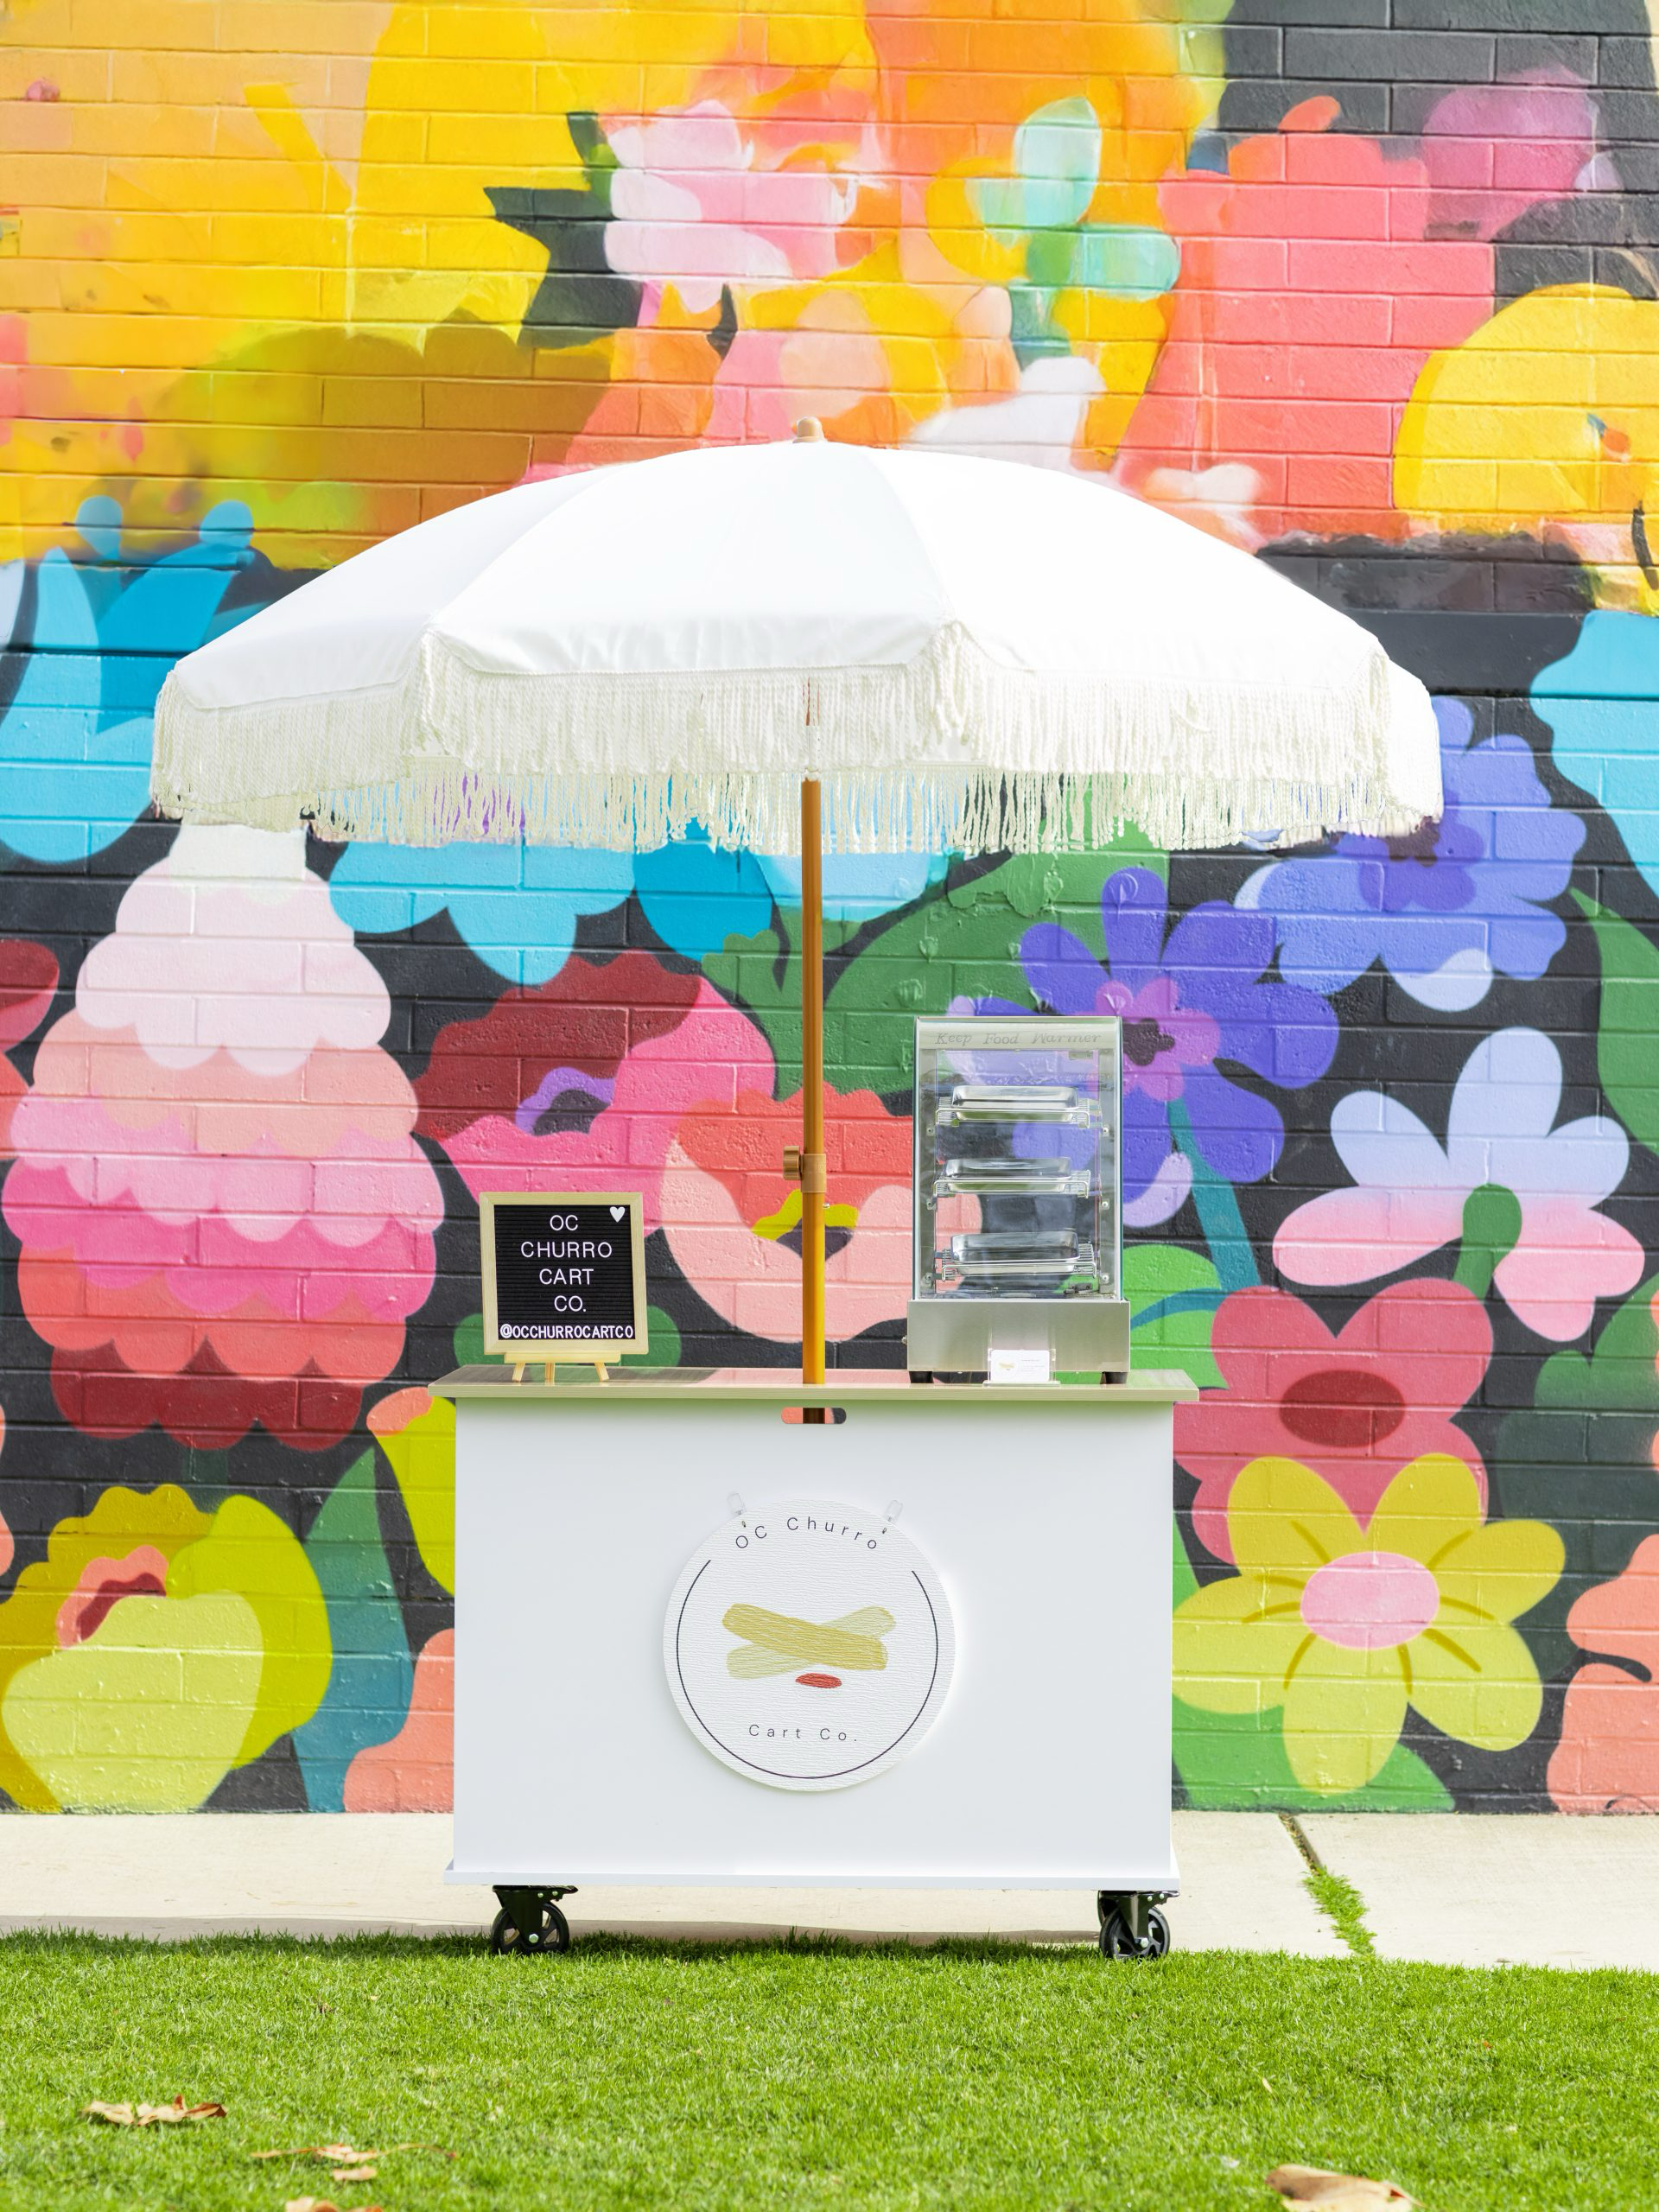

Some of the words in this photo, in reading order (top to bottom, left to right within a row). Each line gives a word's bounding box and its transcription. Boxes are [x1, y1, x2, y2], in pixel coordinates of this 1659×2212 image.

[934, 1032, 972, 1046] Keep
[982, 1032, 1020, 1045] Food
[1031, 1032, 1103, 1045] Warmer
[550, 1214, 579, 1231] OC
[520, 1241, 613, 1258] CHURRO
[538, 1268, 594, 1285] CART
[554, 1295, 587, 1312] CO.
[499, 1323, 634, 1339] @OCCHURROCARTCO
[735, 1525, 767, 1549] OC
[786, 1516, 878, 1549] Churro
[748, 1724, 802, 1739] Cart
[819, 1727, 858, 1742] Co.
